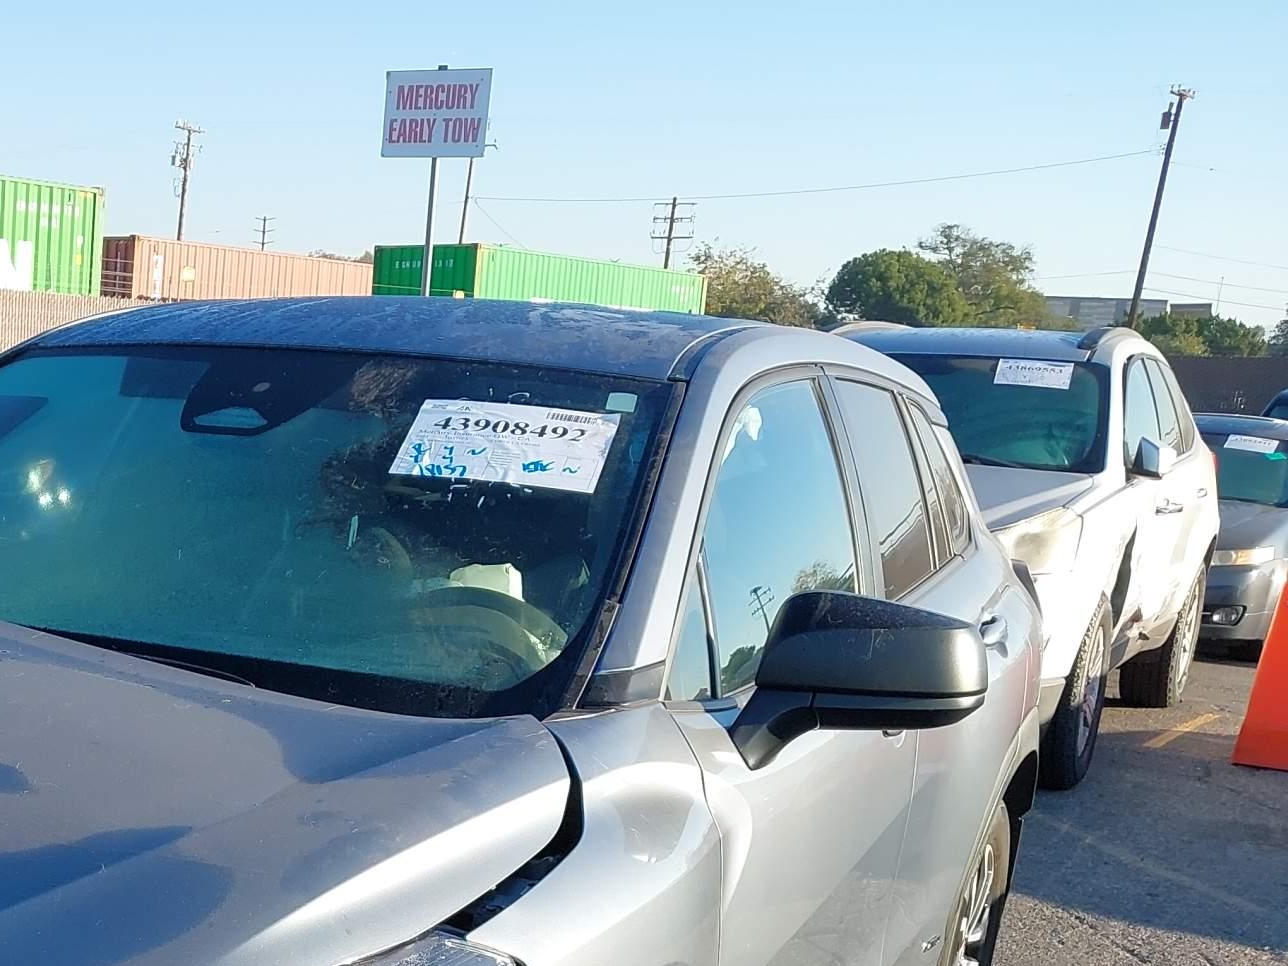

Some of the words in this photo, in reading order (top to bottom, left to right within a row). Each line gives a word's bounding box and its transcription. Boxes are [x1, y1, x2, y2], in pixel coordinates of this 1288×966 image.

[396, 83, 480, 110] MERCURY
[388, 117, 437, 144] EARLY
[443, 117, 482, 144] TOW
[433, 415, 588, 442] 43908492
